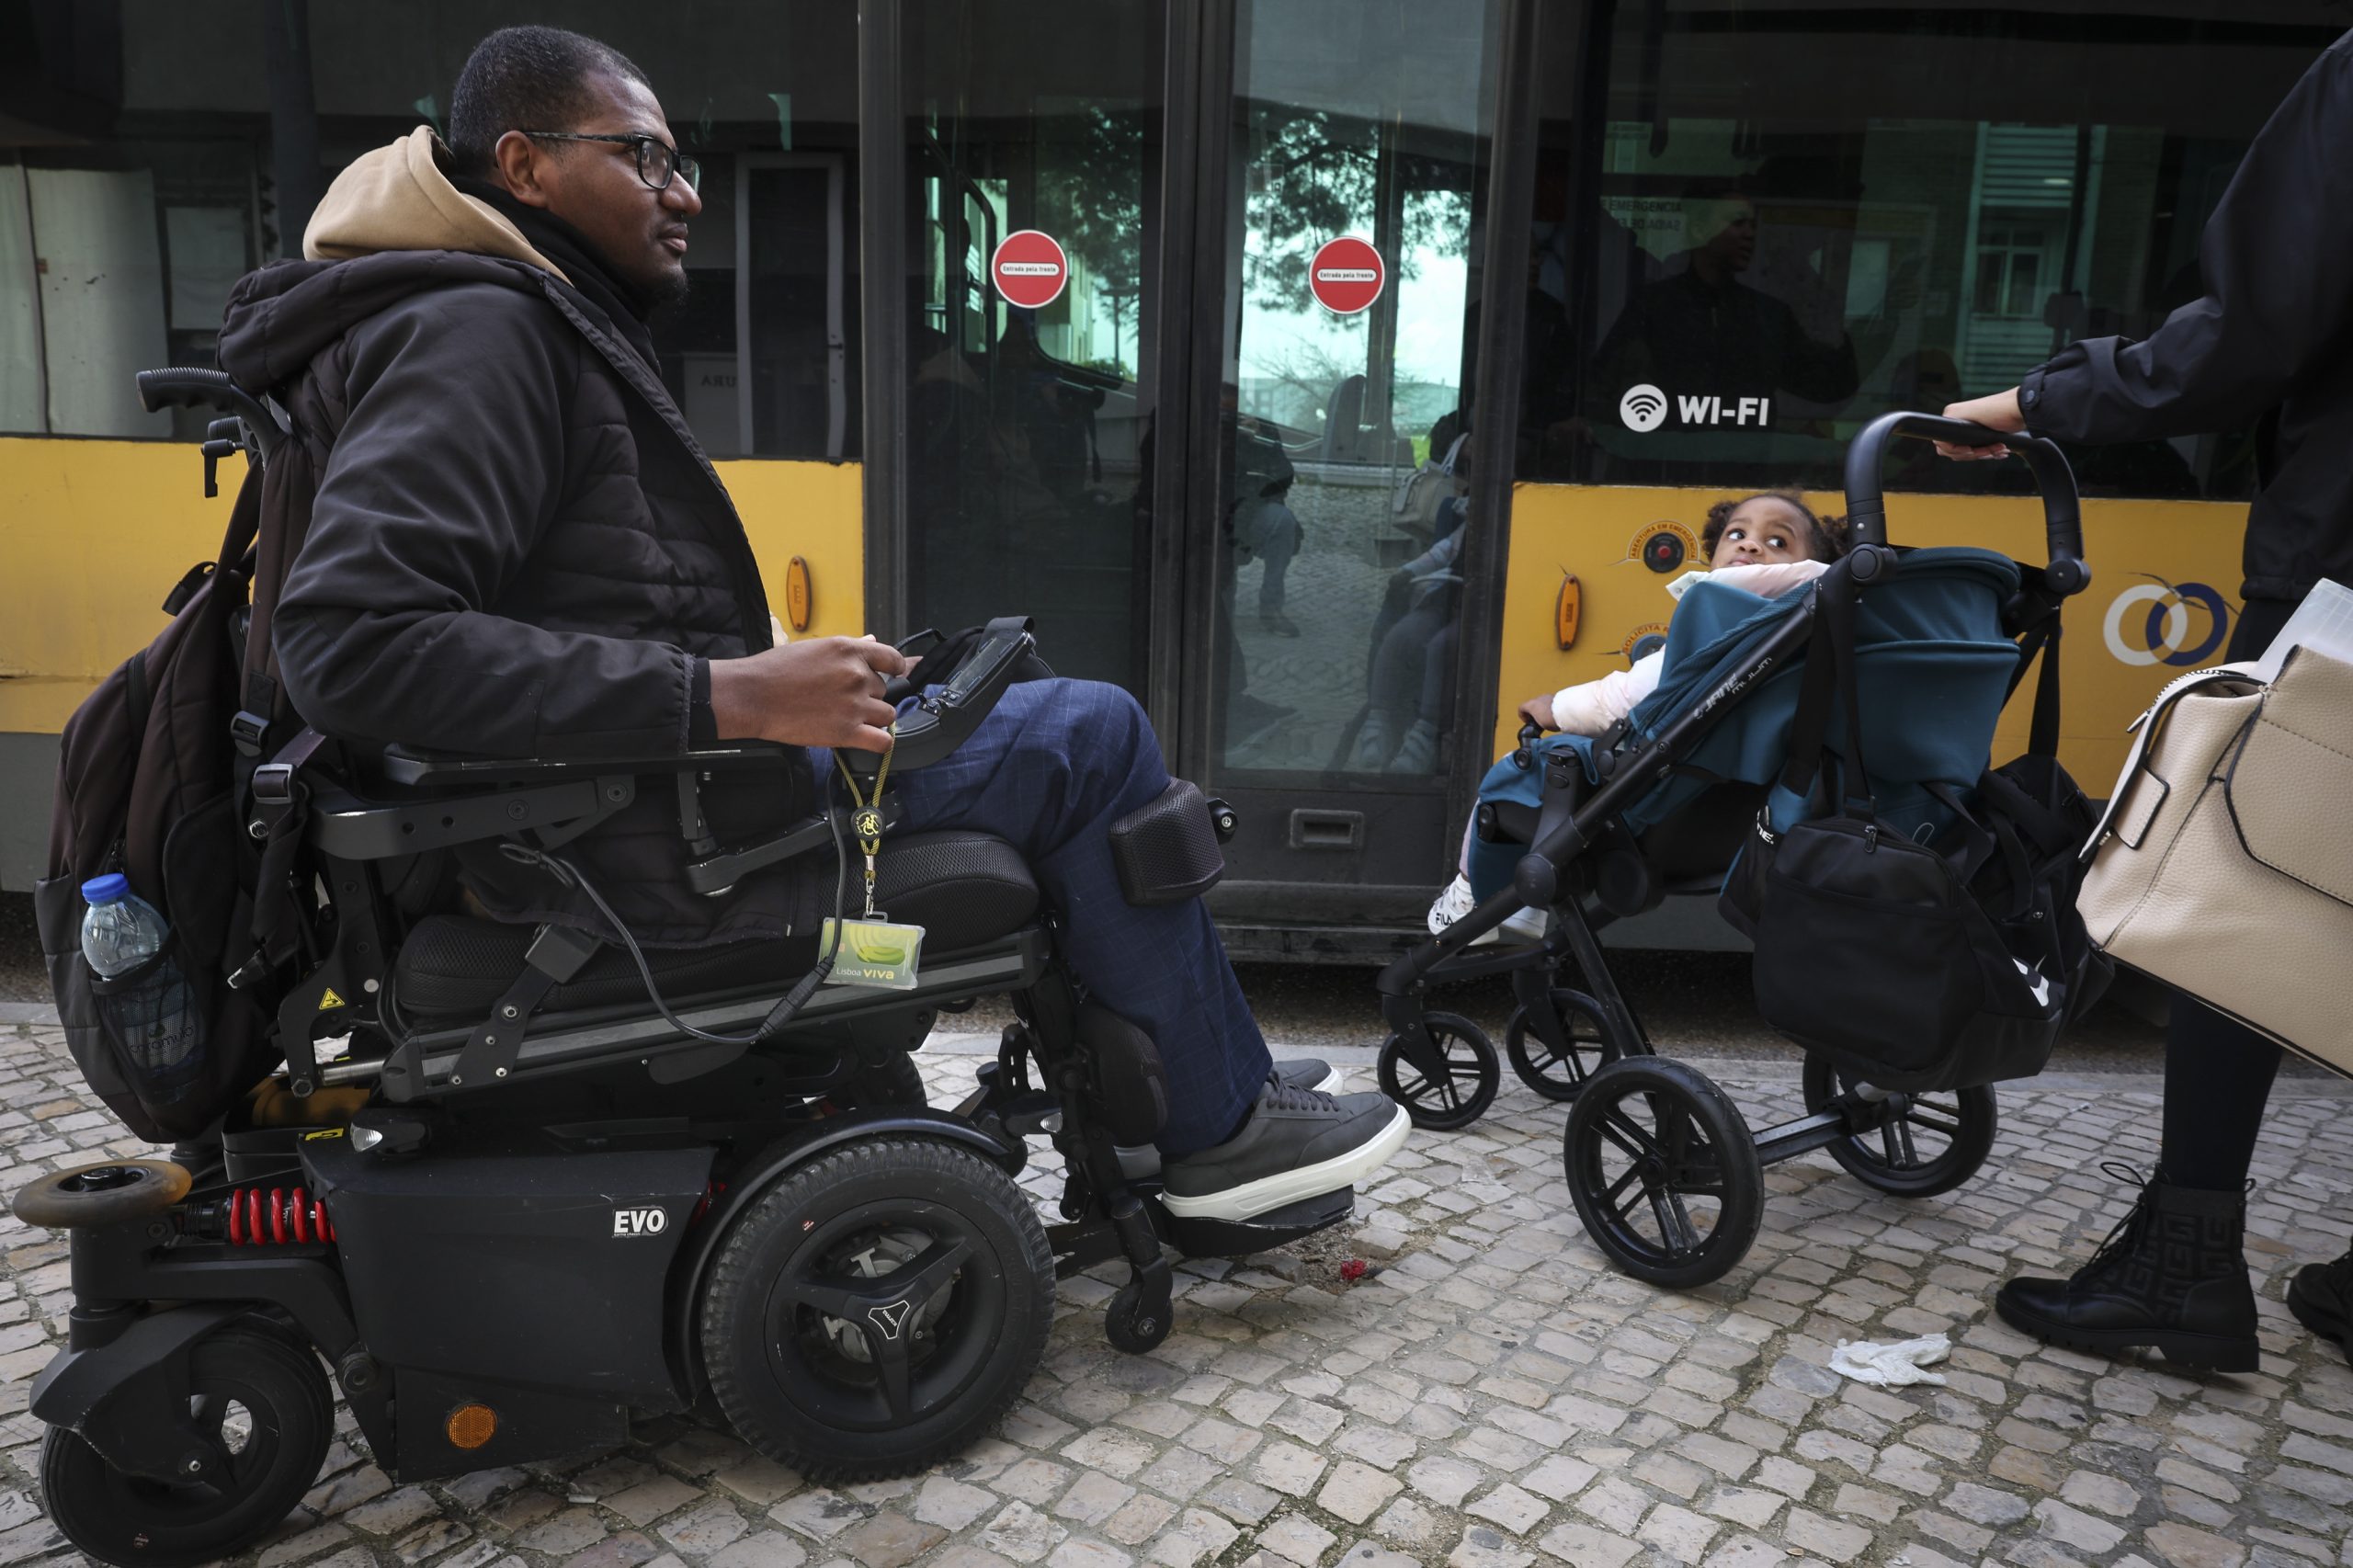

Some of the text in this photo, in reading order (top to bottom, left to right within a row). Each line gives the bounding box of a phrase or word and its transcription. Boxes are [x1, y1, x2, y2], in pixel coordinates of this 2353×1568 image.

[1677, 395, 1769, 426] WI-FI
[1631, 526, 1656, 557] ABERTURA
[1622, 625, 1661, 653] SOLICITA
[835, 967, 861, 977] Lisboa
[614, 1210, 665, 1233] EVO
